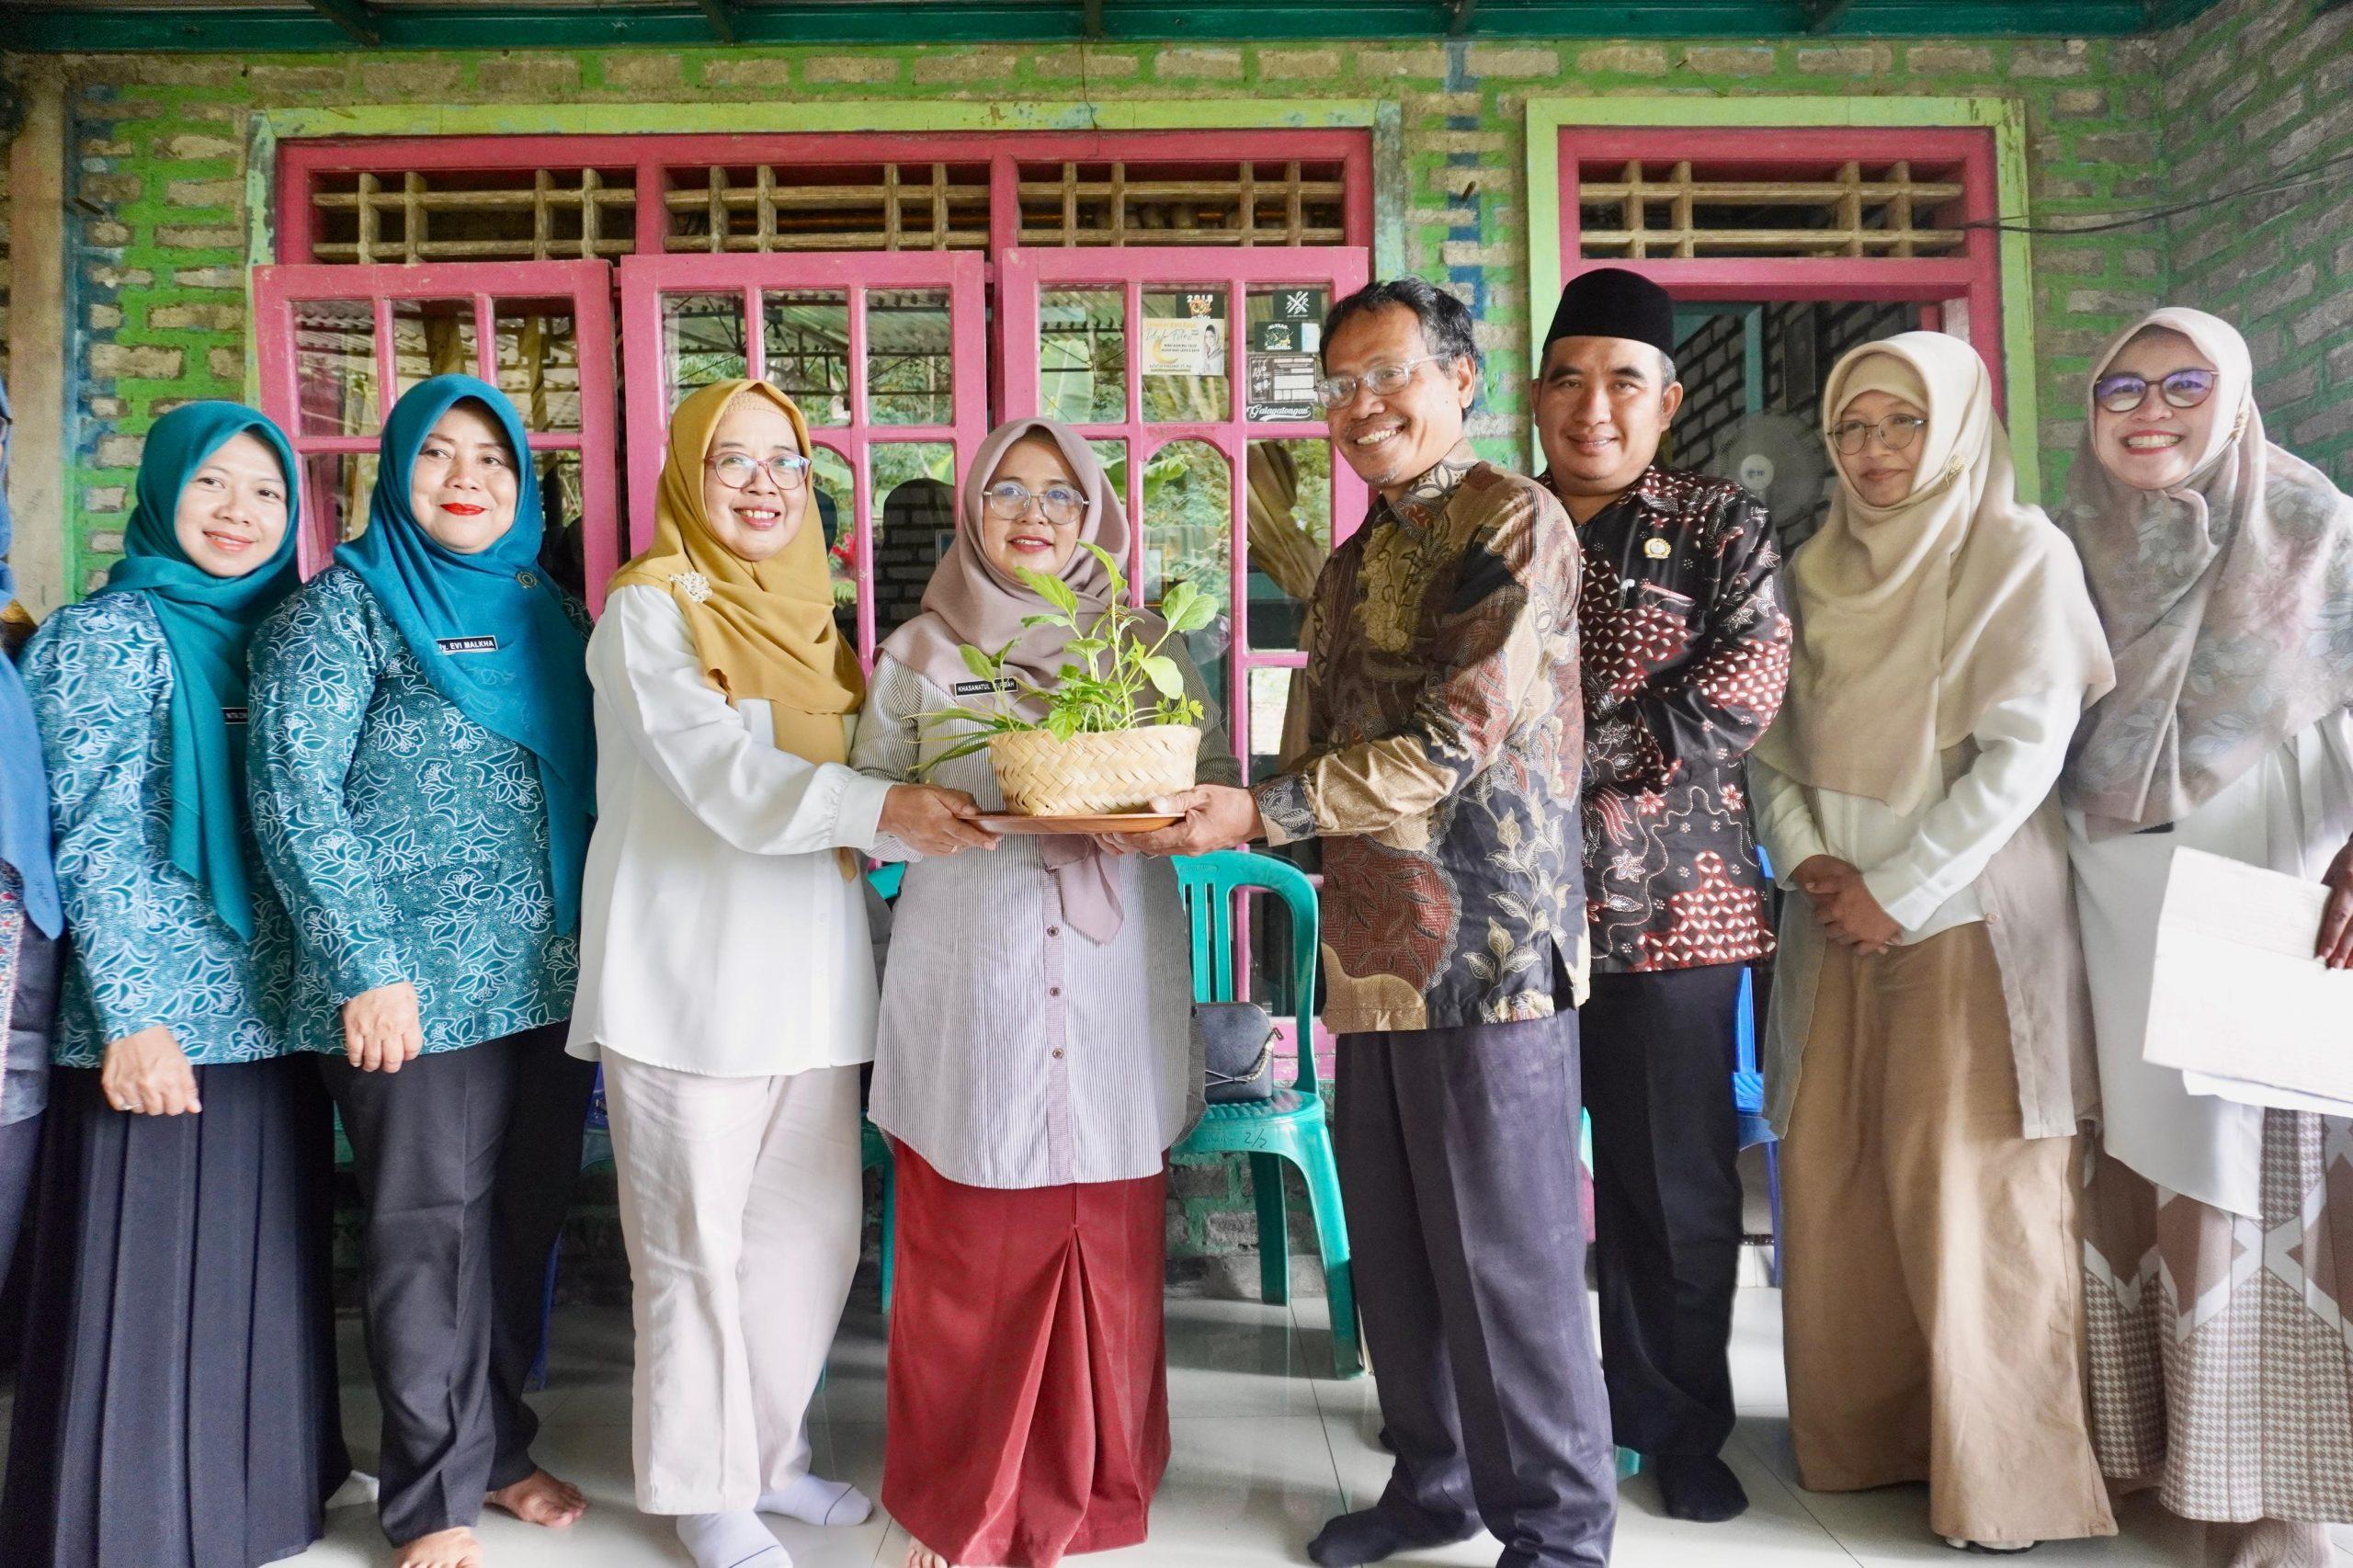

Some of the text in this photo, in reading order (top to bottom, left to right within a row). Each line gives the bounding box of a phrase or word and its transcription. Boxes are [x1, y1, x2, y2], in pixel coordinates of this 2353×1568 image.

[449, 642, 463, 650] EVI
[463, 640, 494, 649] MALKHA
[958, 684, 991, 693] KHASANATUL
